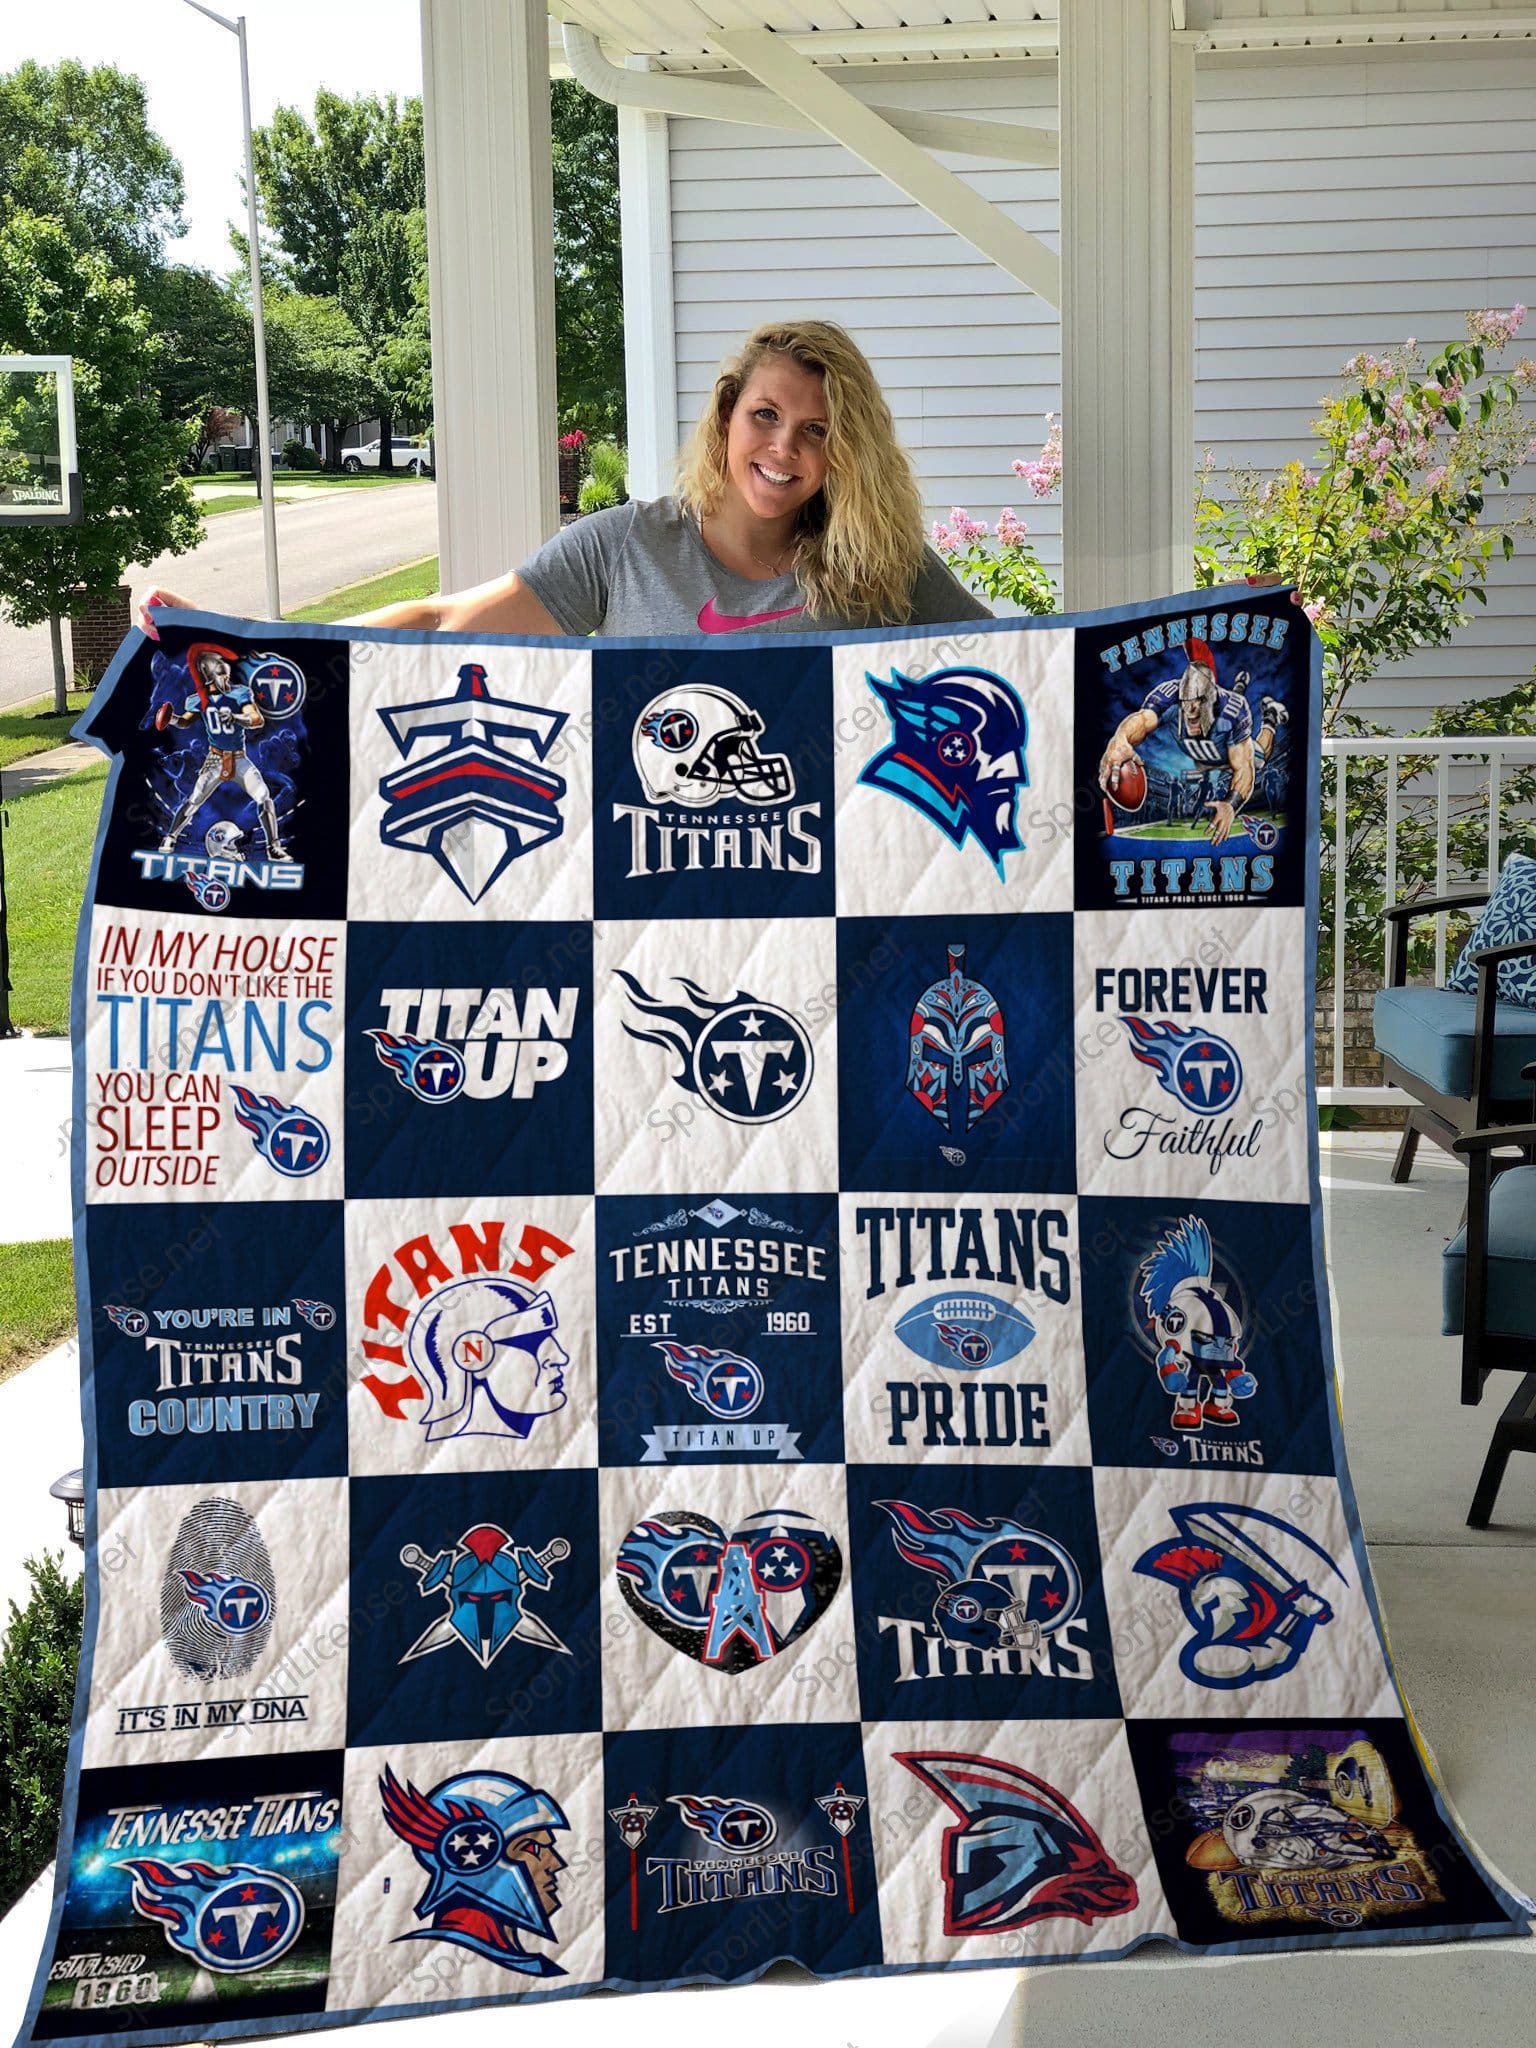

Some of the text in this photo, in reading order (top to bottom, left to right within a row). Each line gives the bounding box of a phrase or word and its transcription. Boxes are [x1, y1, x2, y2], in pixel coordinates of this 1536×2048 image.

[12, 489, 60, 502] SPALDING
[1100, 612, 1290, 673] TENNESSEE
[1184, 738, 1222, 761] 00
[665, 811, 782, 825] TENNESSEE
[613, 801, 822, 879] TITANS
[131, 850, 305, 890] TITANS
[1110, 855, 1274, 895] TITANS
[99, 925, 338, 974] IN MY HOUSE
[97, 967, 333, 998] IF YOU DON'T LIKE THE
[1095, 967, 1268, 1014] FOREVER
[97, 994, 333, 1073] TITANS
[379, 987, 580, 1041] TITAN
[96, 1072, 220, 1103] YOU CAN
[461, 1040, 569, 1100] UP
[710, 1040, 795, 1111] T
[95, 1105, 220, 1152] SLEEP
[1103, 1107, 1263, 1176] Faithful
[95, 1155, 220, 1187] OUTSIDE
[608, 1237, 827, 1283] TENNESSEE
[856, 1207, 1071, 1305] TITANS
[667, 1276, 770, 1298] TITANS
[153, 1307, 291, 1330] YOU'RE IN
[360, 1221, 576, 1421] TITANS
[629, 1311, 810, 1334] EST 1960
[145, 1333, 302, 1392] TITANS
[185, 1339, 273, 1351] TENNESSEE
[463, 1340, 483, 1363] N
[128, 1393, 321, 1436] COUNTRY
[886, 1382, 1051, 1447] PRIDE
[673, 1429, 776, 1447] TITAN UP
[1182, 1434, 1264, 1466] TITANS
[119, 1699, 306, 1731] IT'S IN MY DNA
[104, 1804, 253, 1850] TENNESSEE
[647, 1845, 838, 1914] TITANS
[694, 1851, 799, 1870] TENNESSEE
[1217, 1864, 1425, 1914] TITANS
[80, 1977, 154, 2007] 1960
